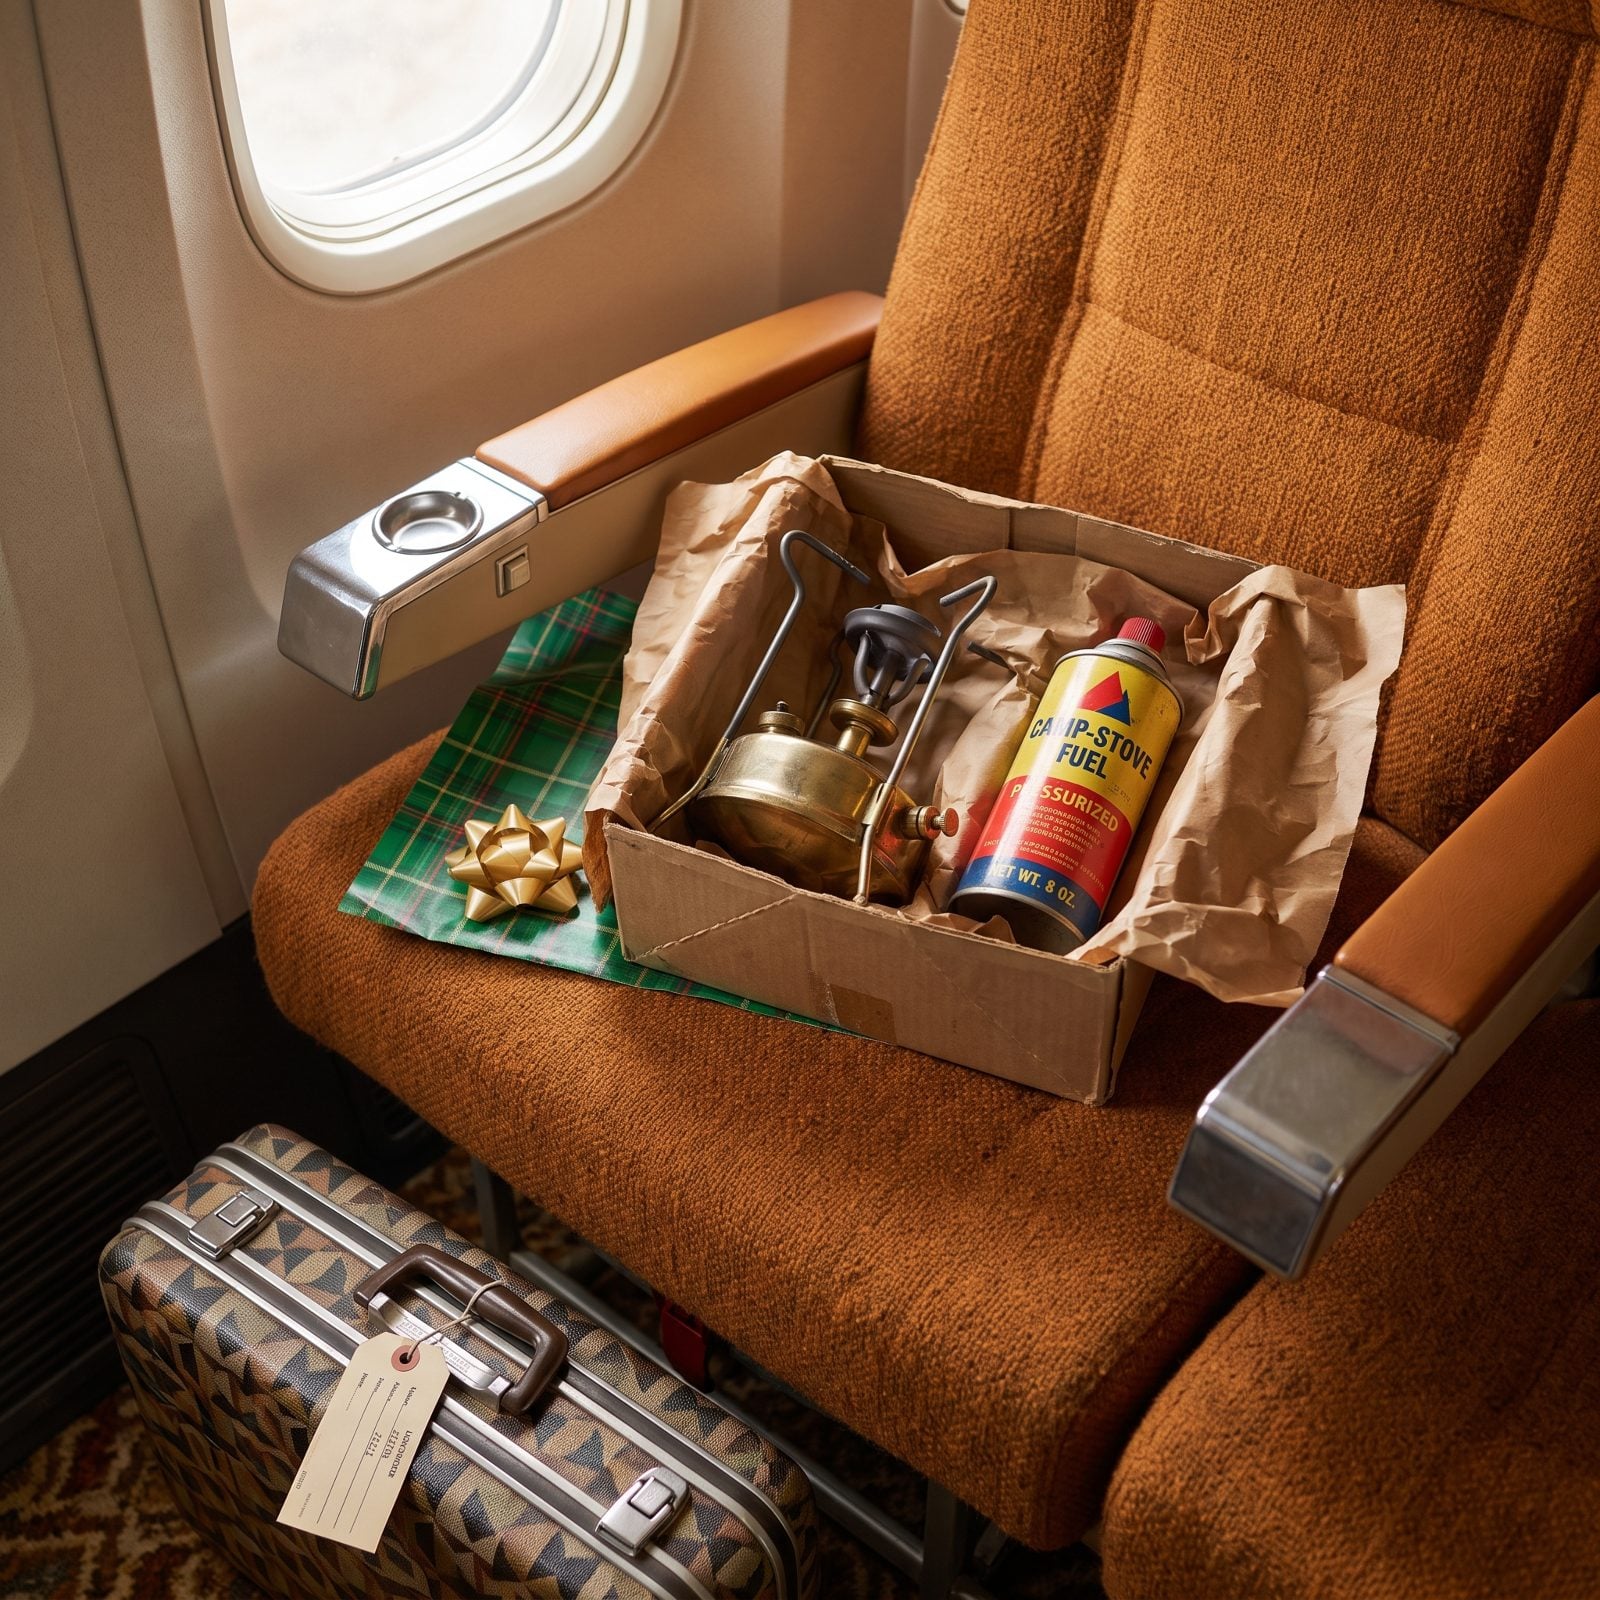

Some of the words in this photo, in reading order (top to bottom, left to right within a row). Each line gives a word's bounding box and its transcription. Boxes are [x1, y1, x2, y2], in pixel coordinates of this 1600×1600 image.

[1056, 743, 1108, 780] FUEL
[1010, 784, 1119, 832] PSSURIZED
[991, 862, 1016, 879] NET
[1018, 867, 1041, 888] WT.
[1044, 879, 1056, 894] 8
[1057, 886, 1075, 909] OZ.
